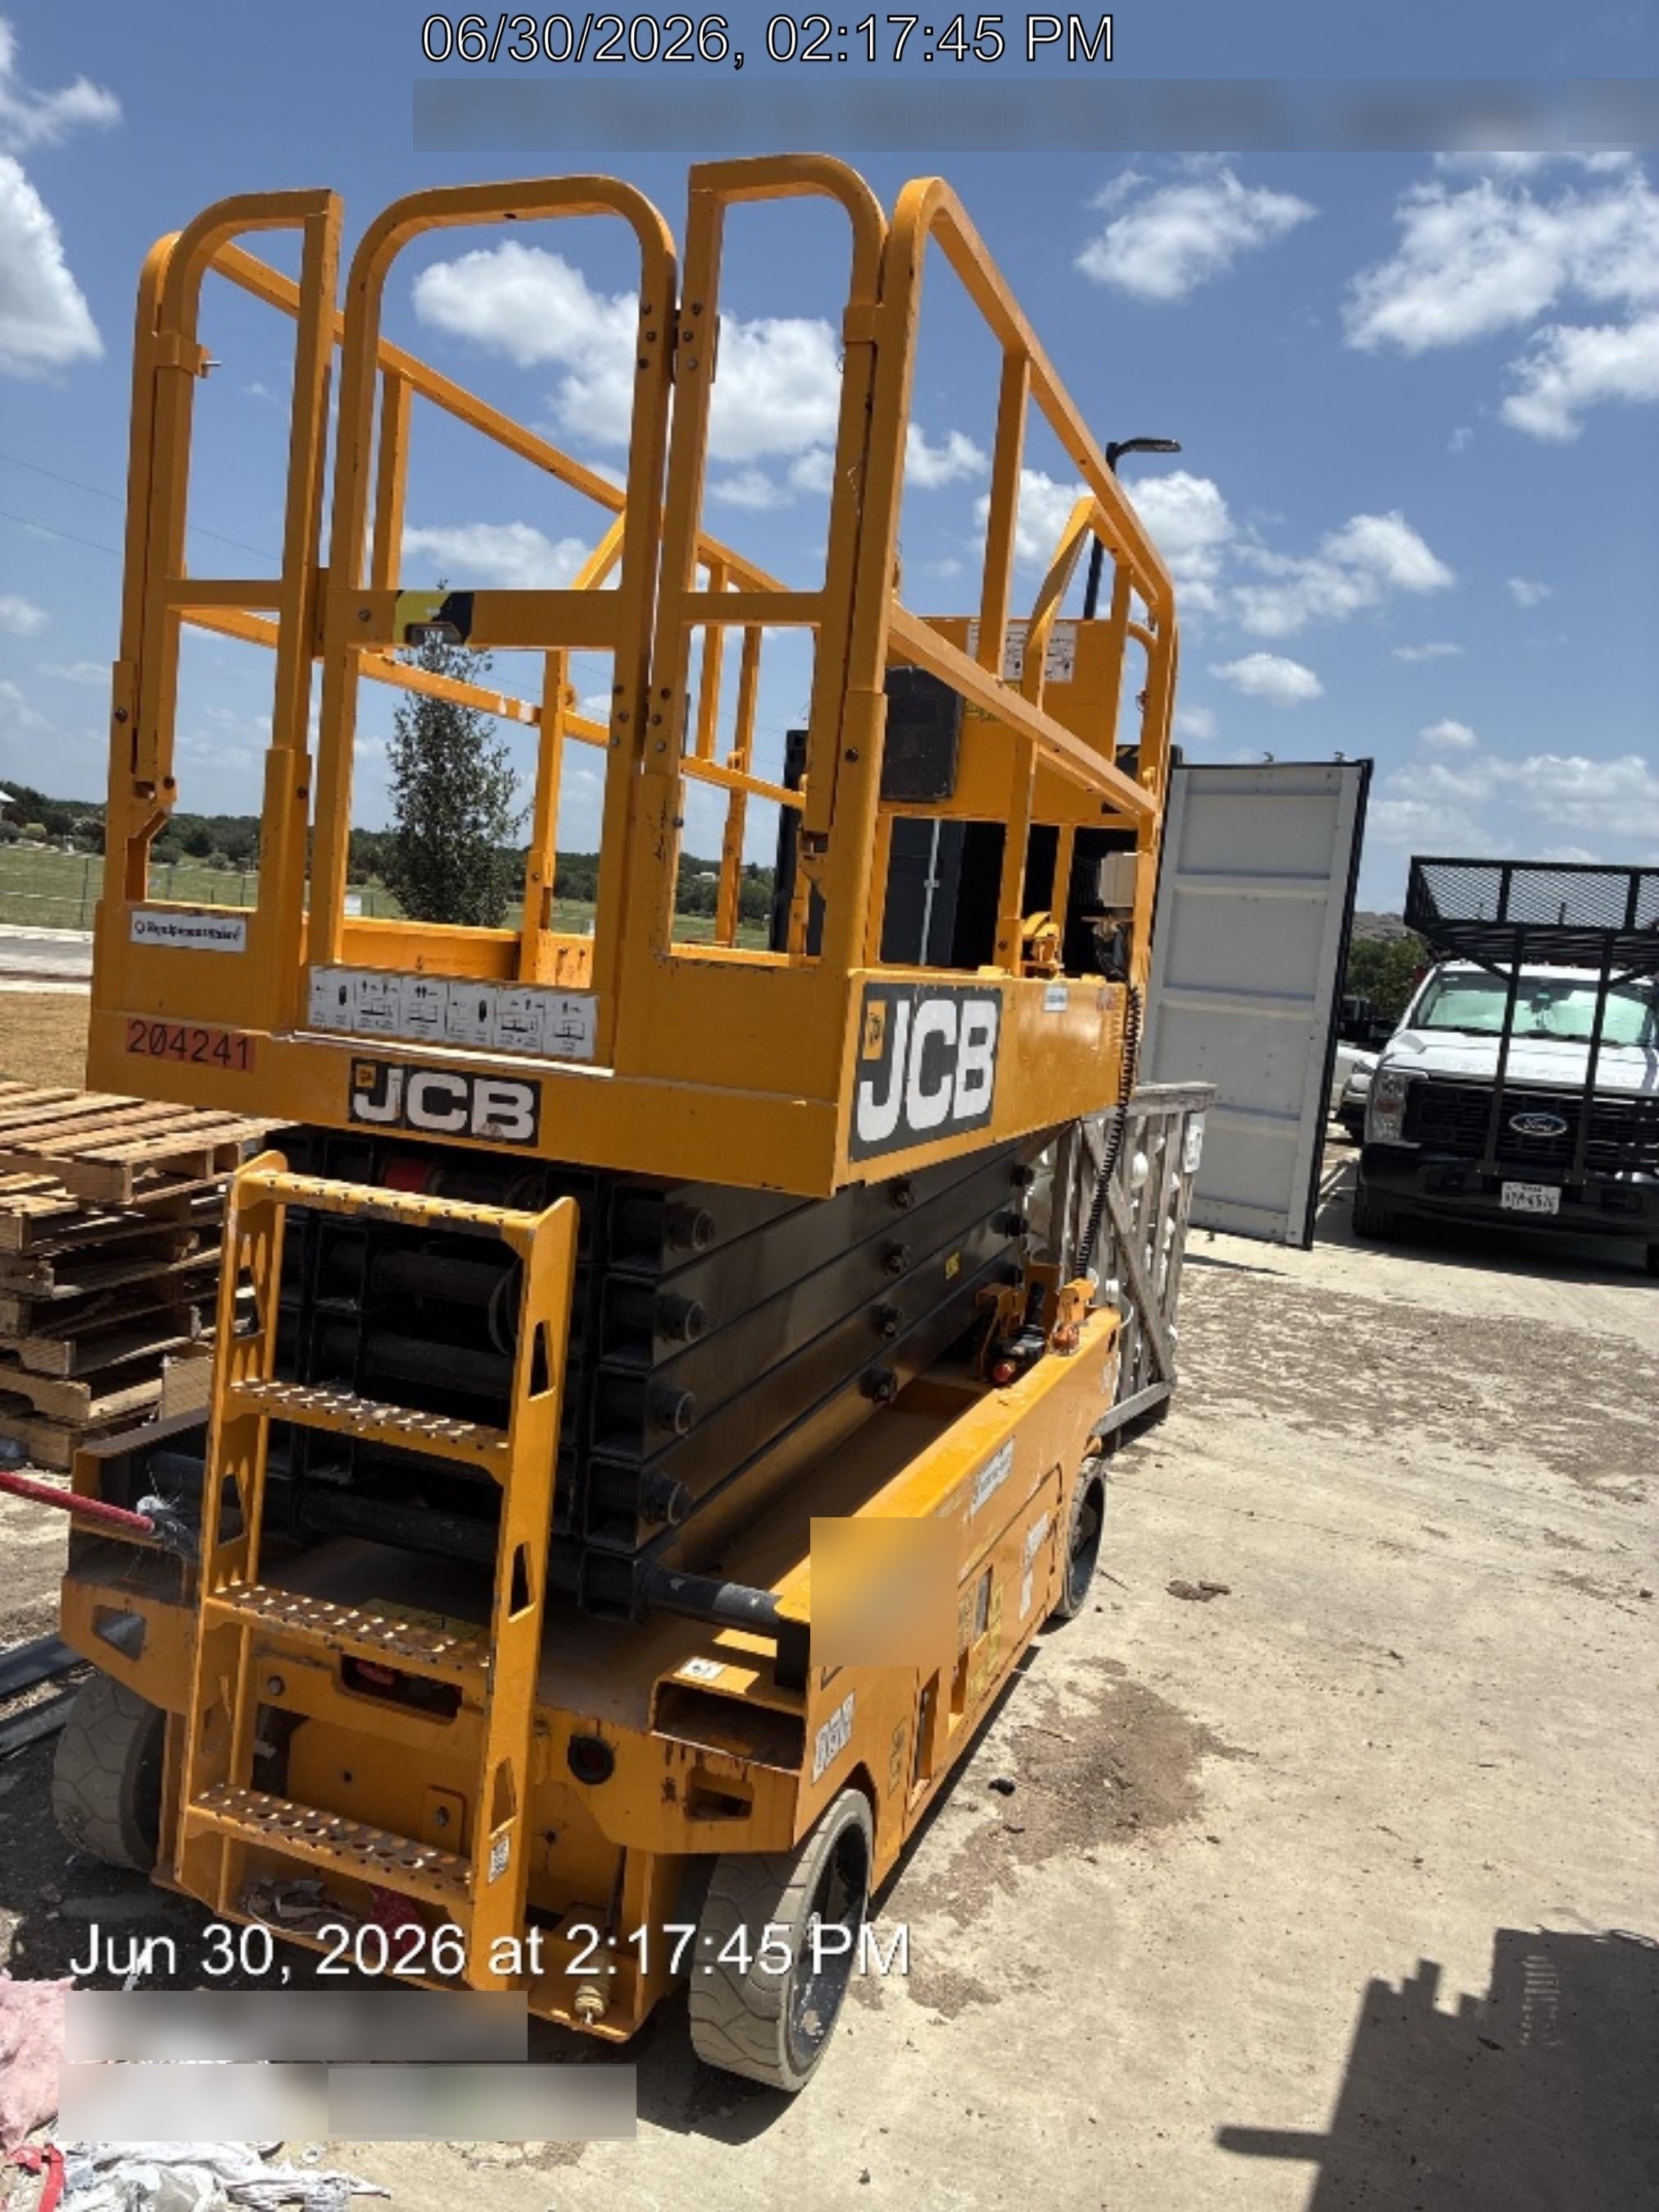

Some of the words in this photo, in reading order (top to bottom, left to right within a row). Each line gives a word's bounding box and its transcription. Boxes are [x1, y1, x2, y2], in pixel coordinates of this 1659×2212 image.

[128, 1019, 249, 1070] 204241
[857, 999, 998, 1143] JCB
[353, 1067, 534, 1140] JCB
